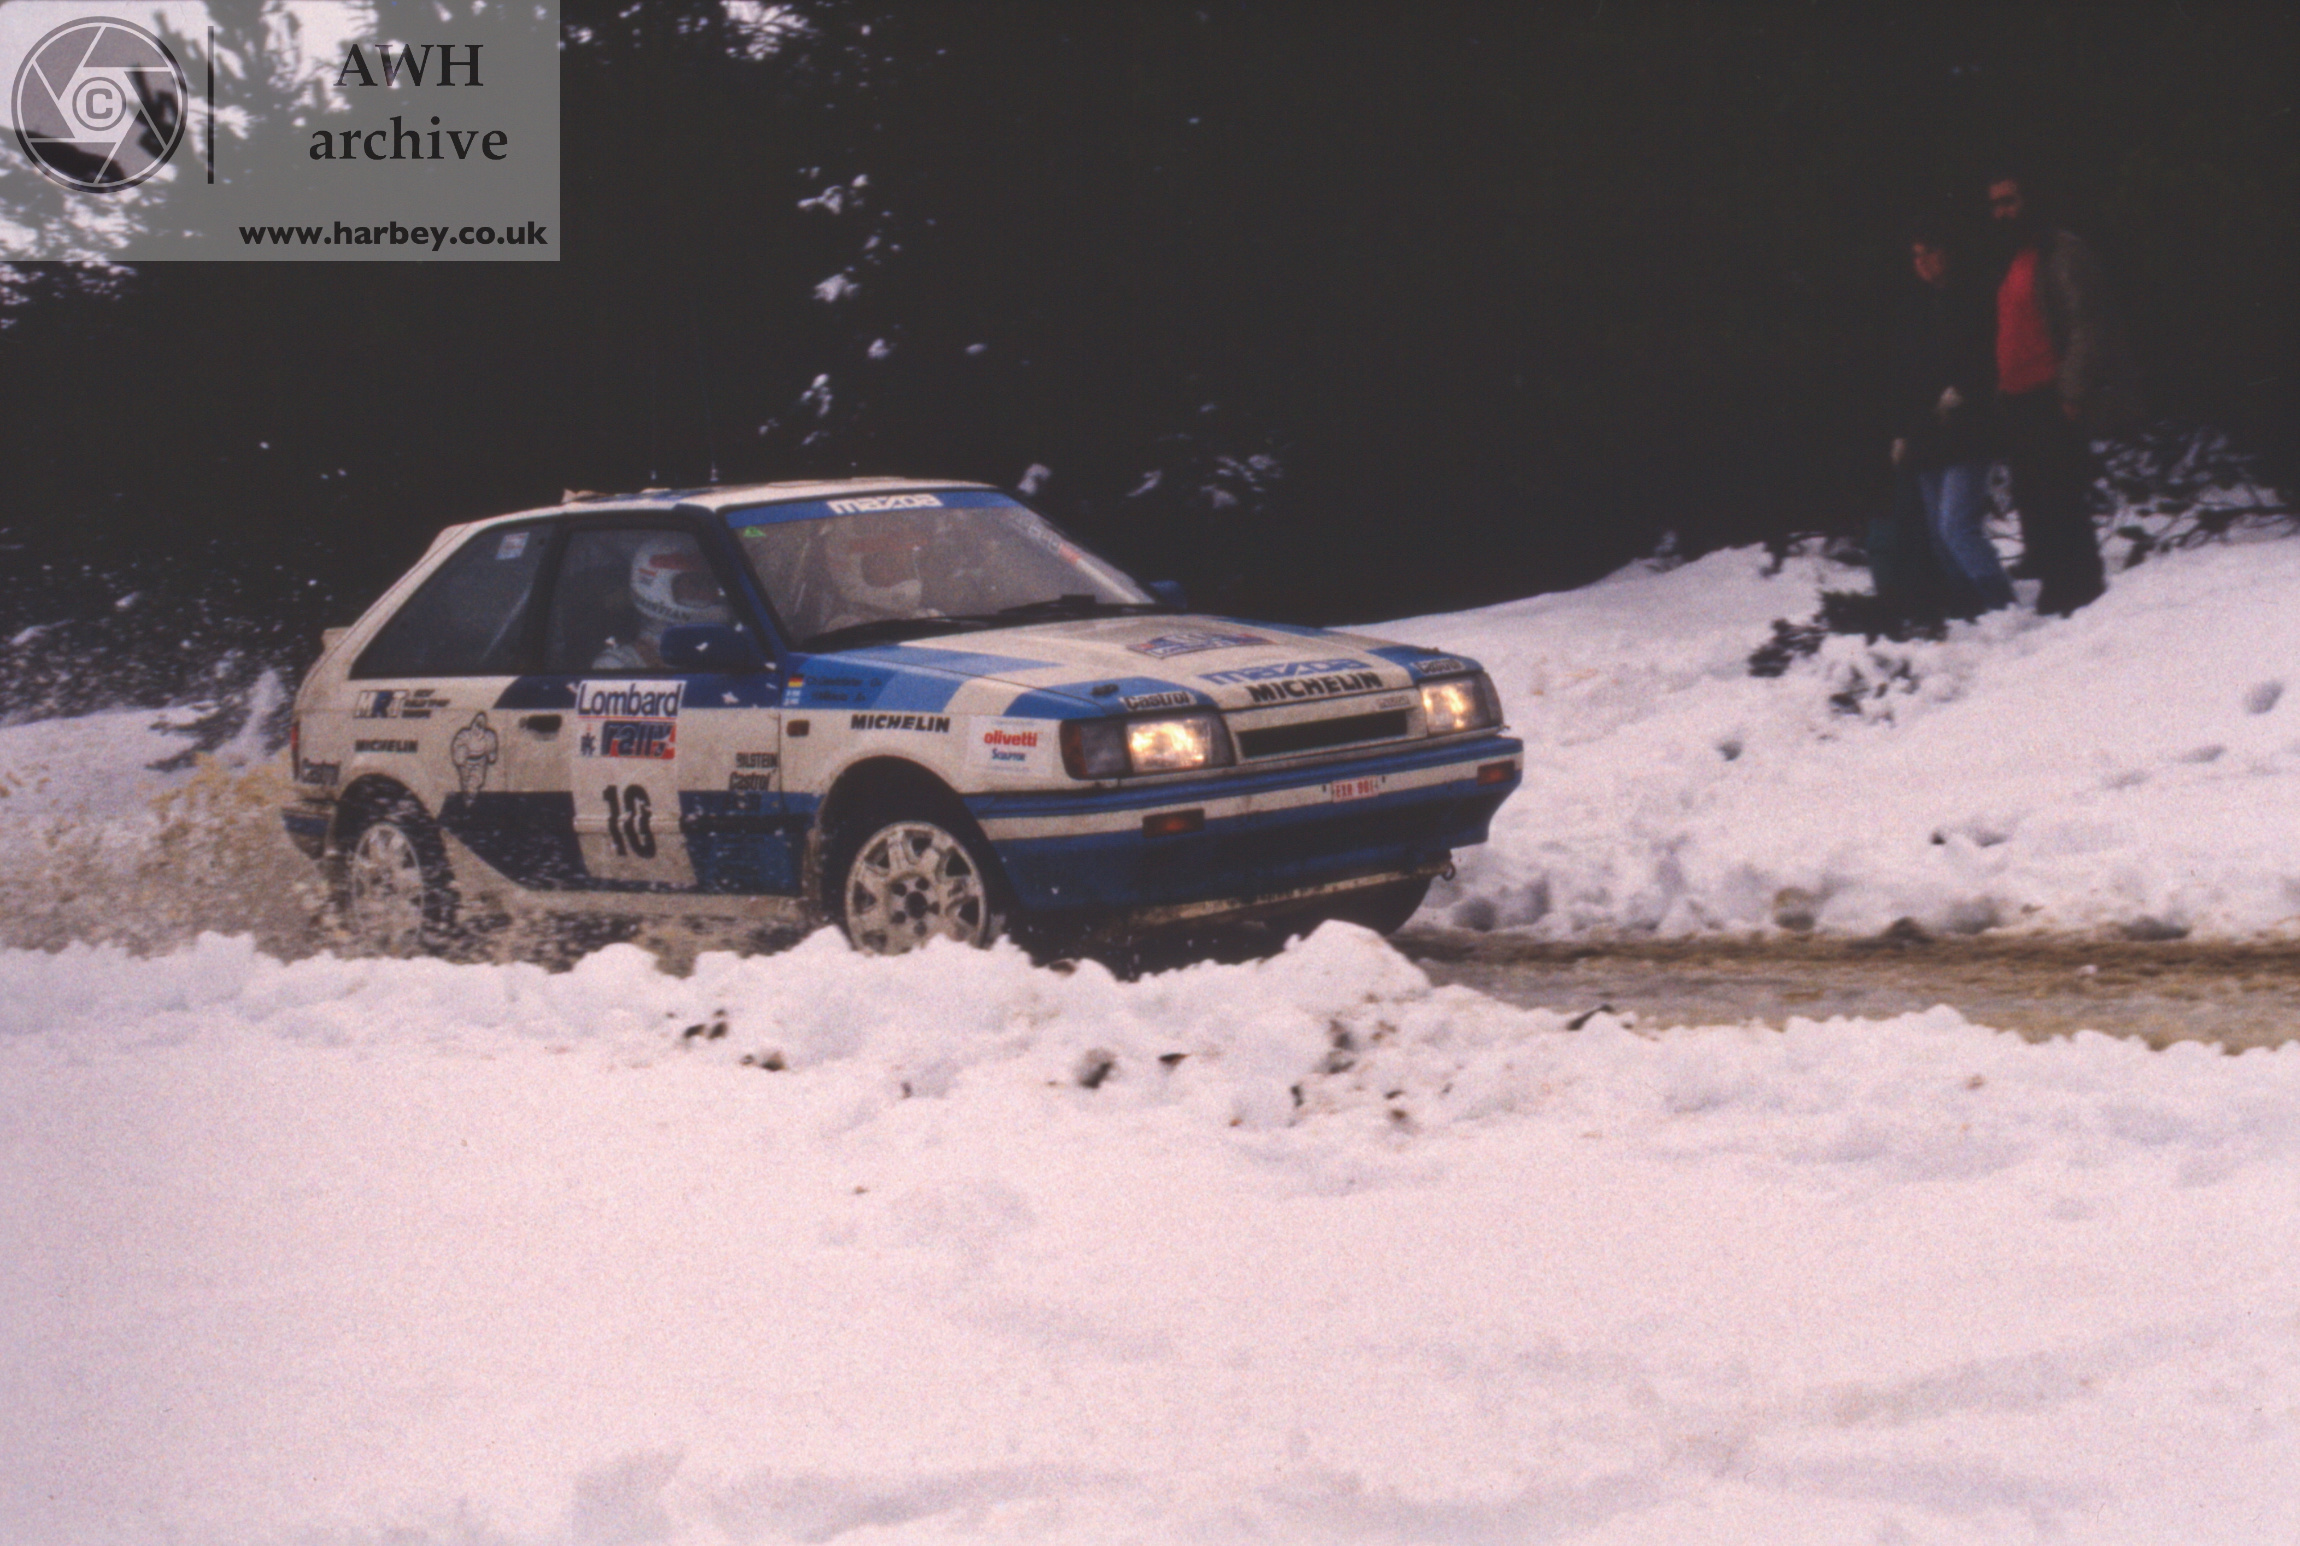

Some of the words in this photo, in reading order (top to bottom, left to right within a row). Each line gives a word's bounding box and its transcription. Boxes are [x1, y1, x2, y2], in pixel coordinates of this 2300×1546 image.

[578, 682, 682, 717] Lombard
[1245, 671, 1384, 703] MICHELIN
[1123, 691, 1191, 710] Castrol
[851, 714, 950, 733] MICHELIN
[984, 730, 1038, 747] olivetti
[602, 784, 657, 859] 10
